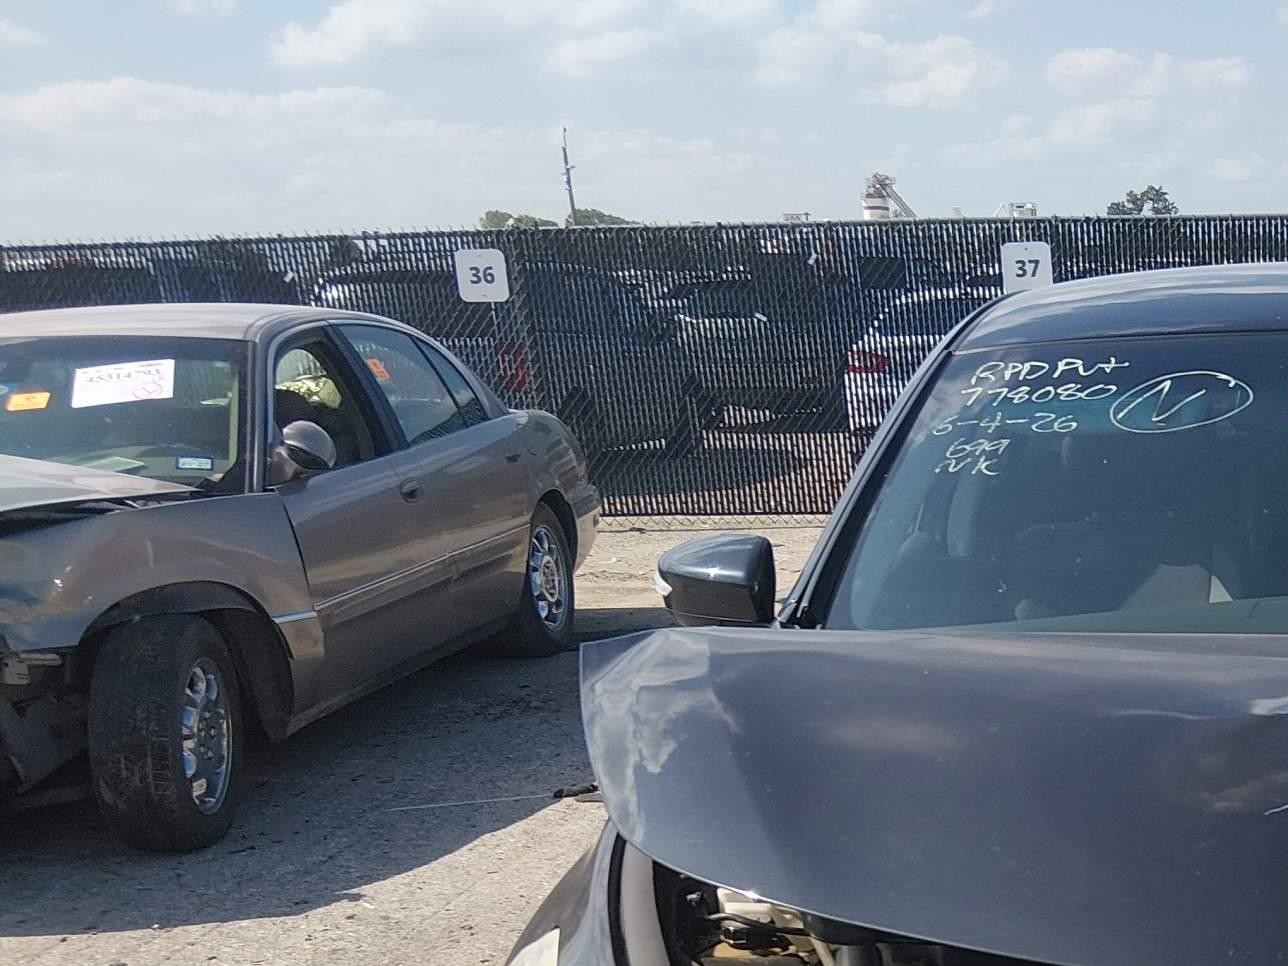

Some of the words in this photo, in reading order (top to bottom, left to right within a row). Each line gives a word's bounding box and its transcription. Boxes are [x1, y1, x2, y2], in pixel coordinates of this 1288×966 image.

[469, 266, 496, 285] 36
[1015, 259, 1040, 278] 37
[960, 383, 1119, 407] 778080
